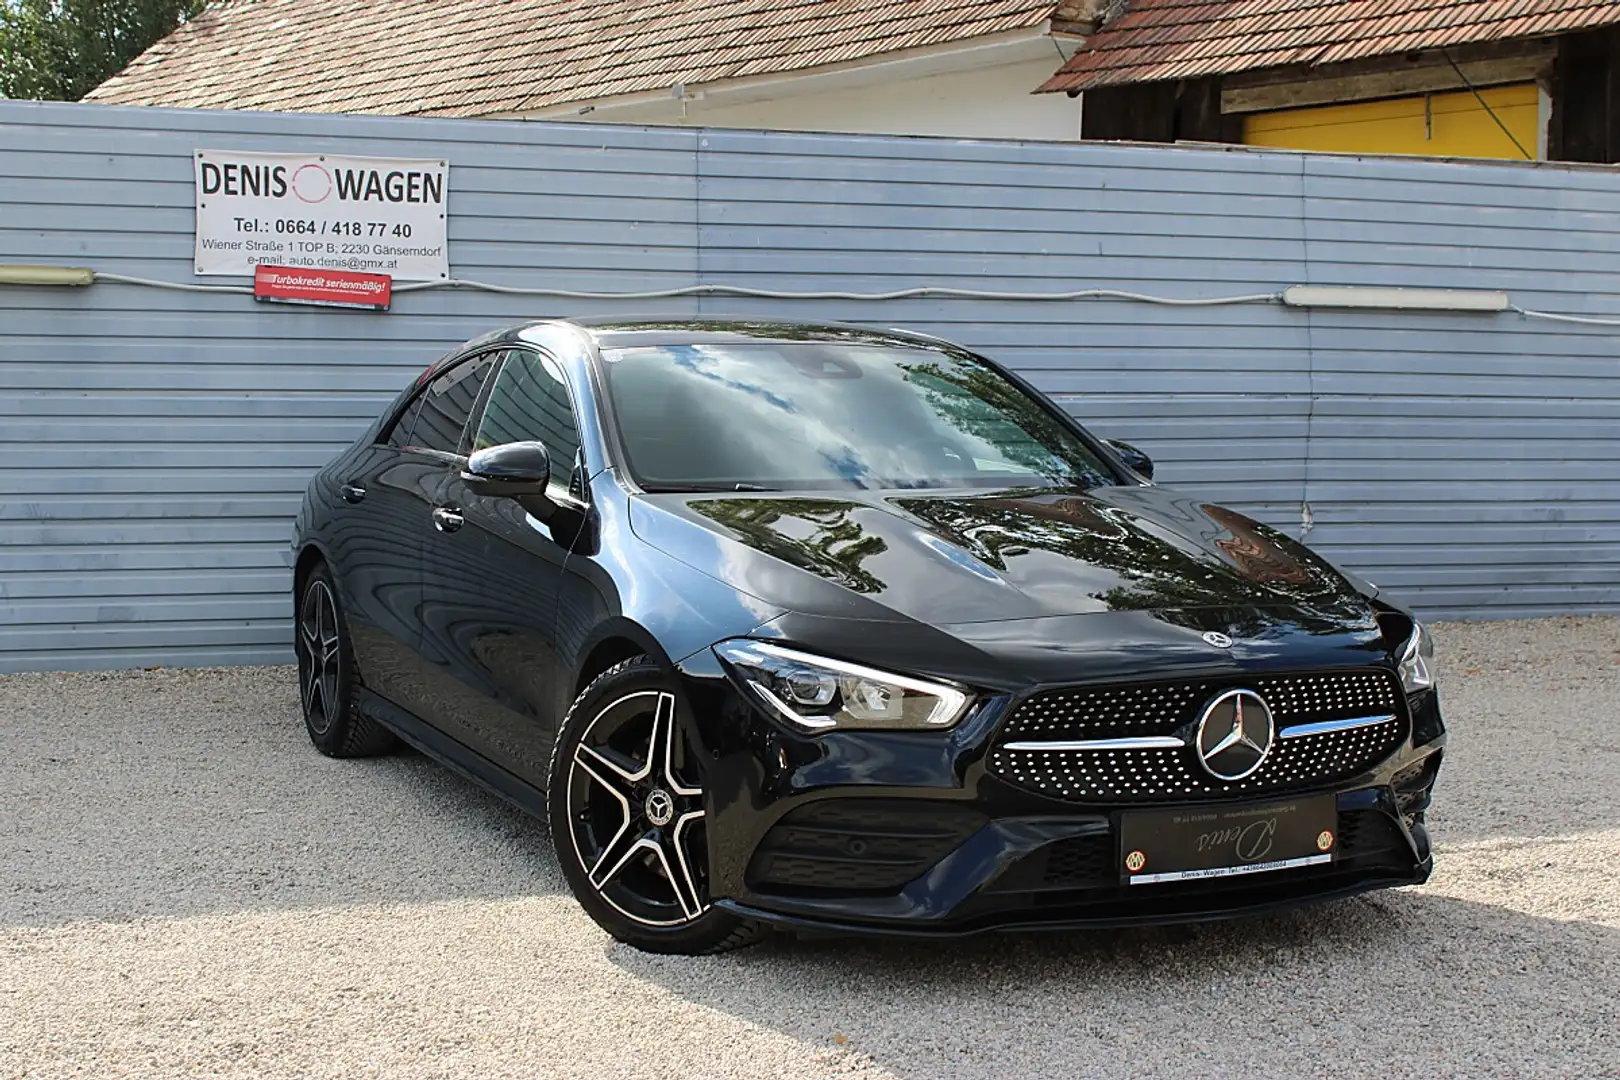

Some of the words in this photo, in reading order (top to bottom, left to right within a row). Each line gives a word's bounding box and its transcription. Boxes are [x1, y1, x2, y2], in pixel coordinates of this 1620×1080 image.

[201, 163, 288, 198] DENIS
[334, 168, 442, 204] WAGEN
[233, 217, 269, 233] Tel.:
[275, 218, 317, 234] 0664
[321, 220, 327, 235] /
[331, 221, 362, 237] 418
[367, 223, 388, 237] 77
[392, 223, 412, 238] 40
[202, 239, 242, 251] Wiener
[245, 240, 284, 253] Straße
[288, 242, 293, 252] 1
[297, 242, 324, 253] TOP
[341, 244, 370, 255] 2230
[373, 244, 442, 257] Gänserndorf
[271, 274, 325, 287] Turbokredit
[326, 279, 387, 294] serienmäßig!
